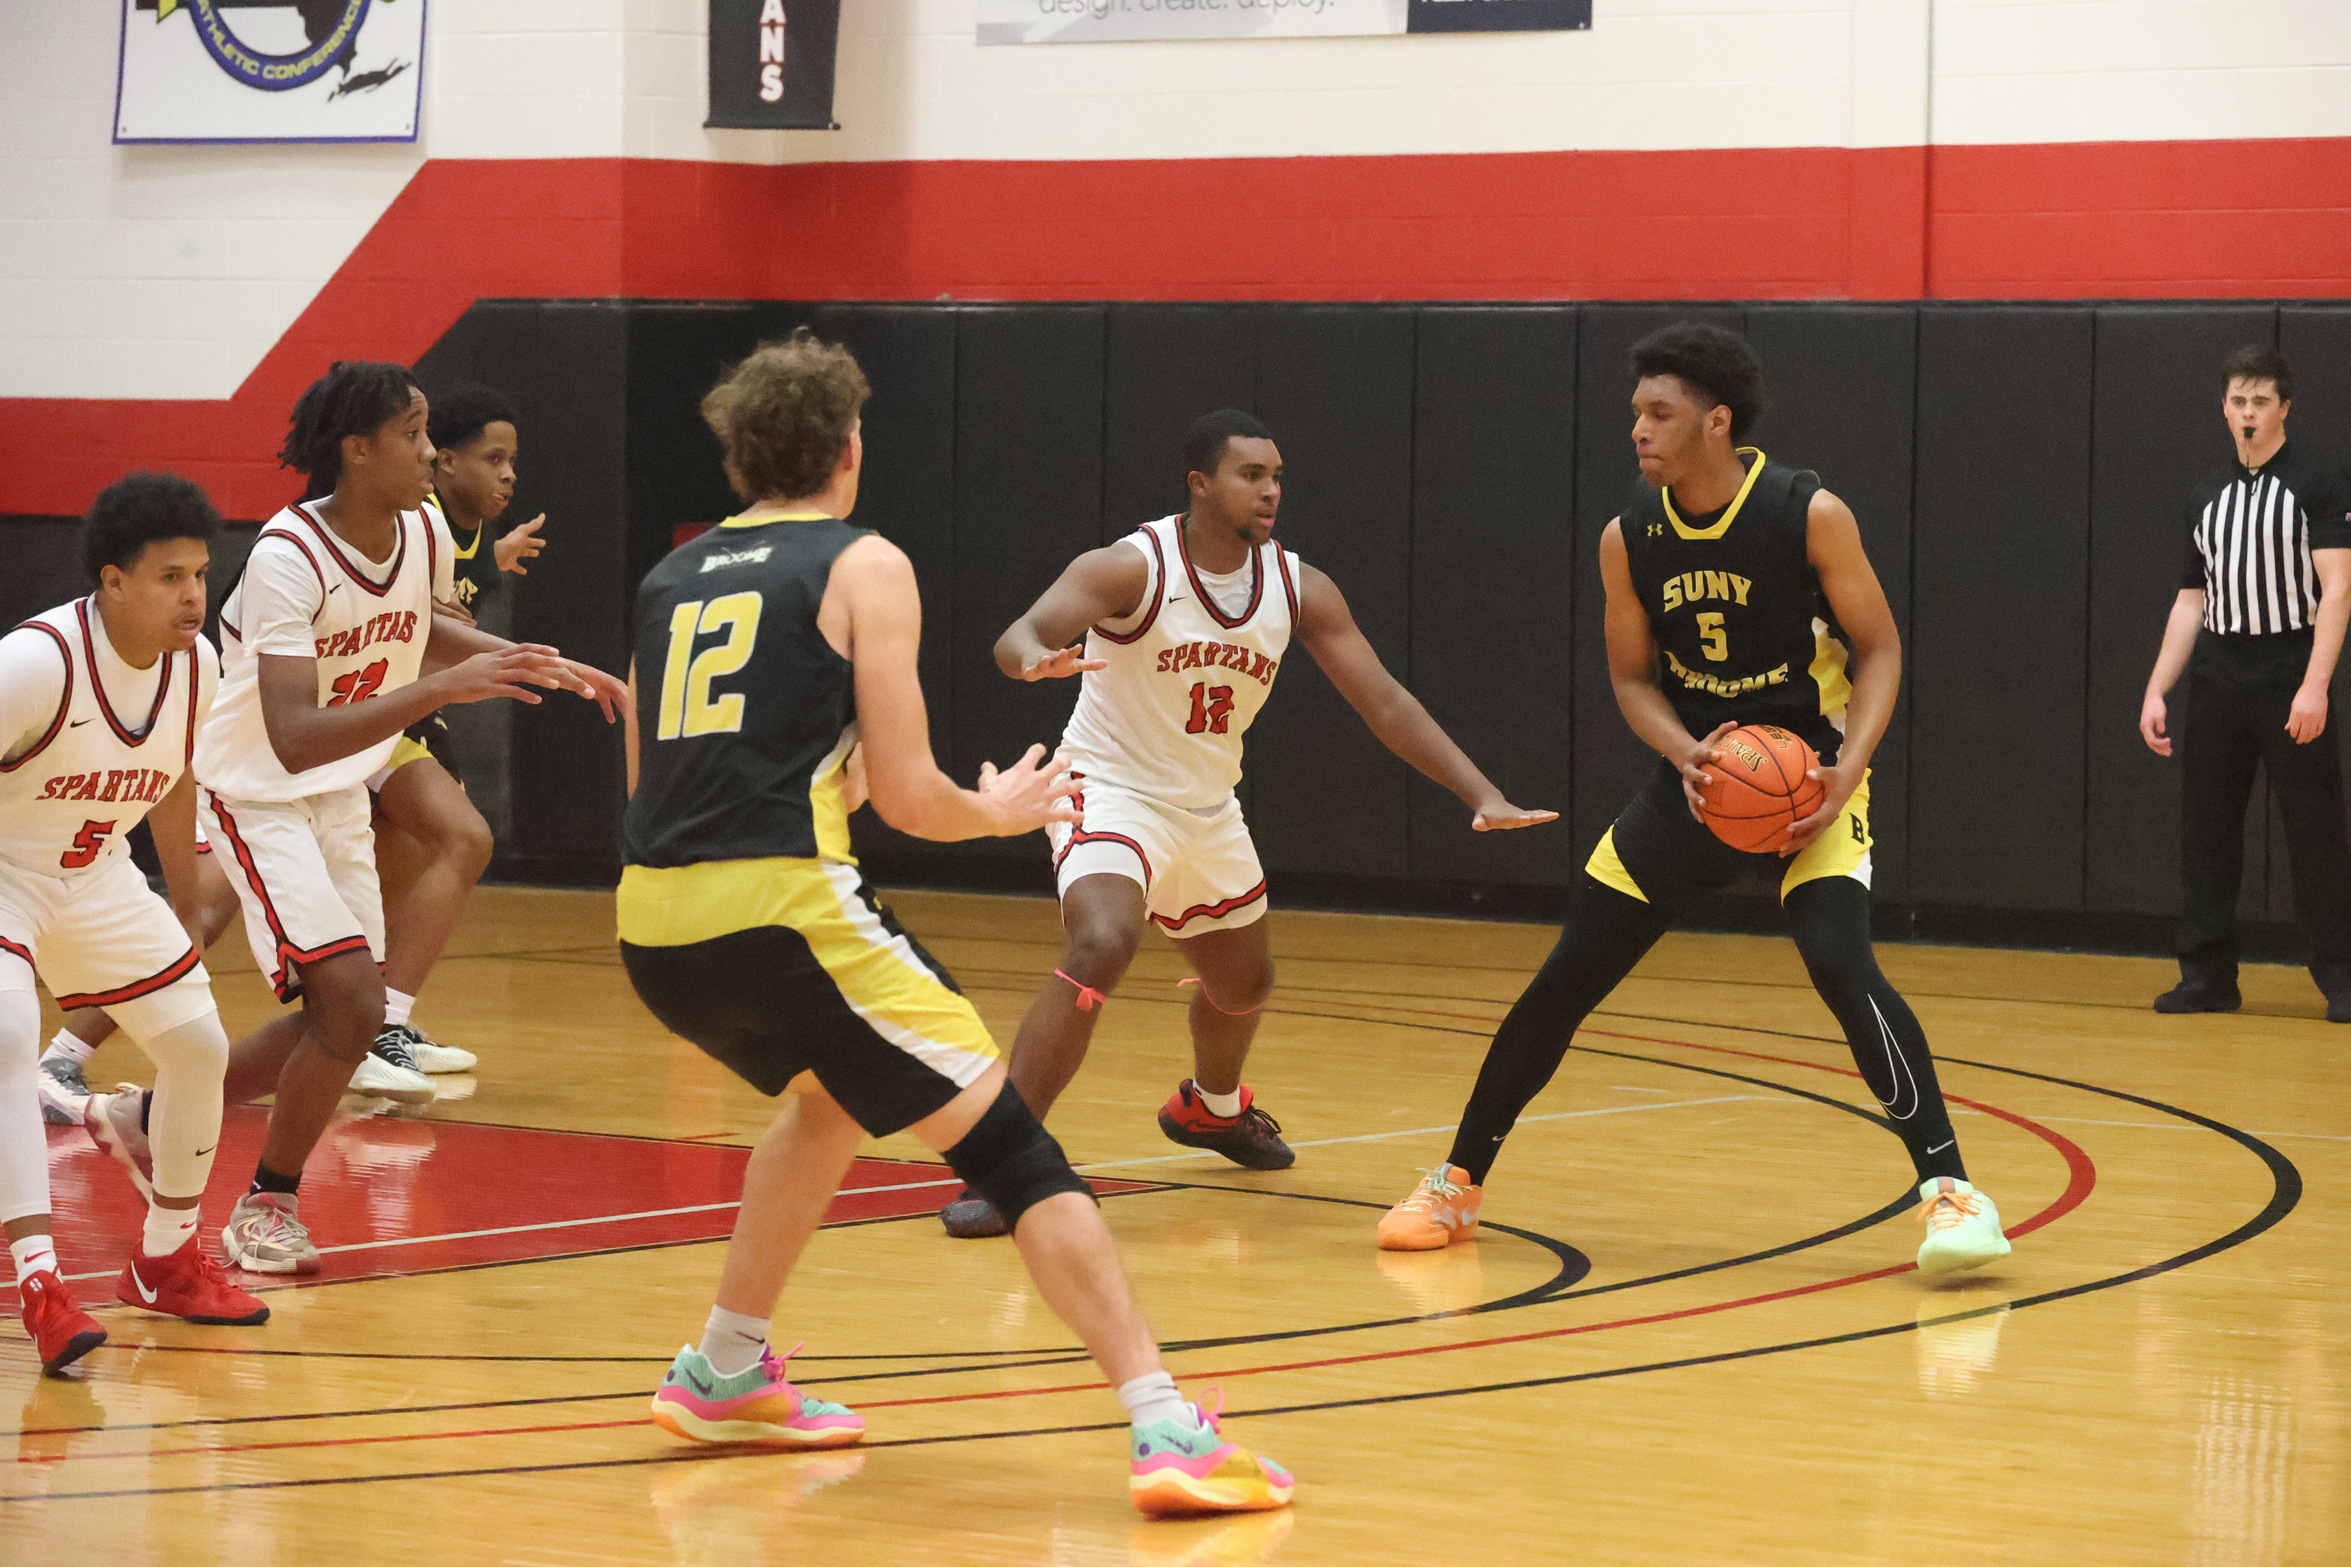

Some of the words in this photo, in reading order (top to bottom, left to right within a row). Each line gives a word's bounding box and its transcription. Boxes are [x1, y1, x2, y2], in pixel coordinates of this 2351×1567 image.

[1663, 570, 1752, 613] SUNY
[314, 610, 418, 659] SPARTAS
[1696, 612, 1729, 662] 5
[657, 591, 764, 741] 12
[1157, 641, 1277, 686] SPARTANS
[1185, 682, 1235, 734] 12
[35, 768, 171, 804] SPARTANS
[60, 819, 118, 869] 5
[1849, 812, 1865, 845] B
